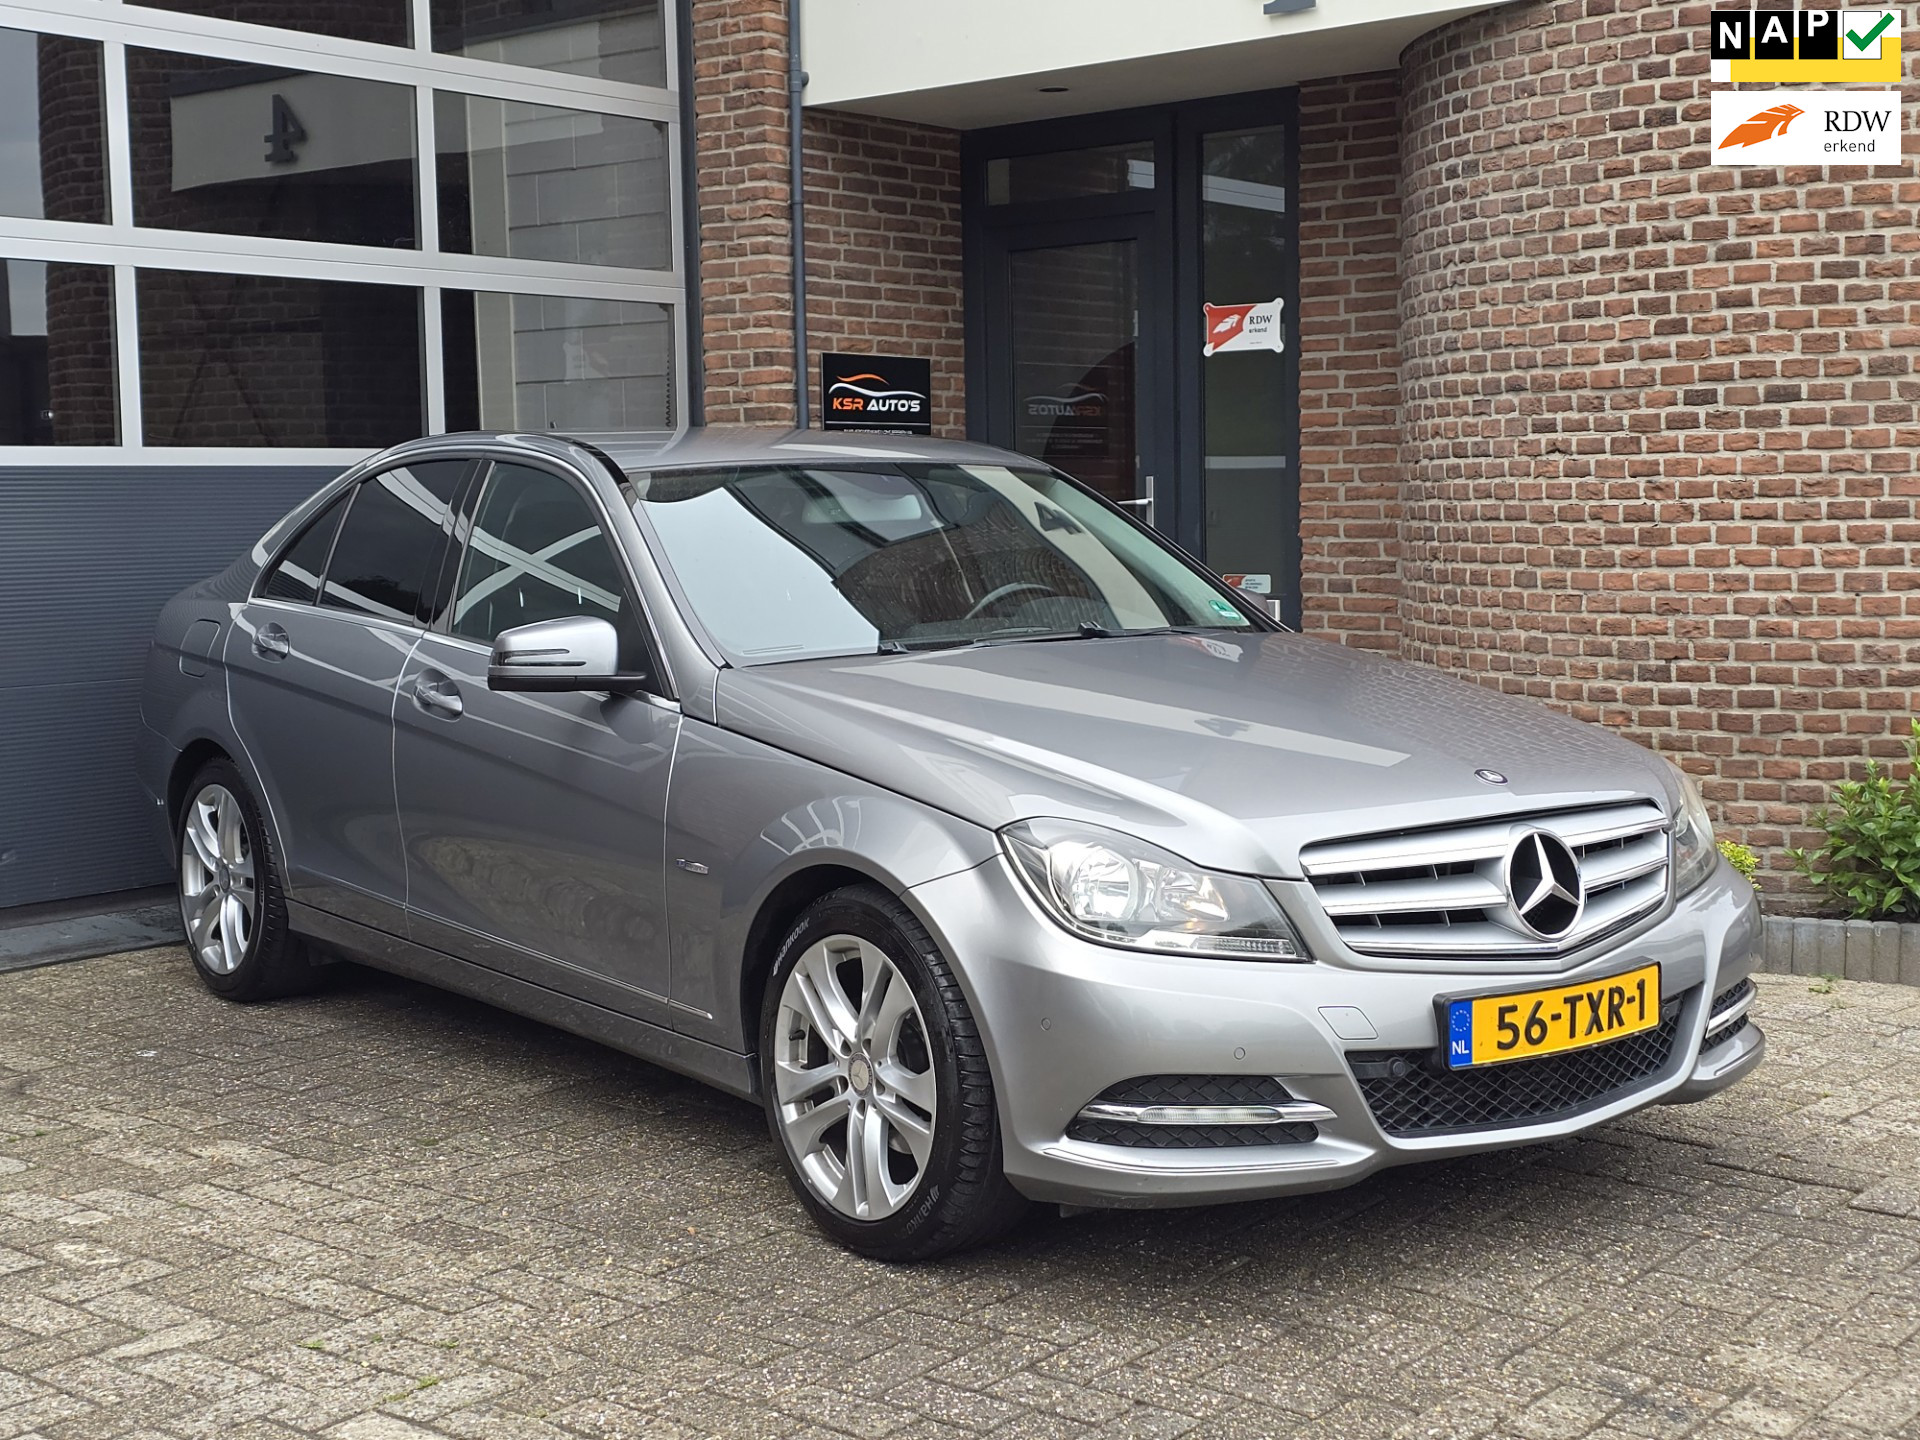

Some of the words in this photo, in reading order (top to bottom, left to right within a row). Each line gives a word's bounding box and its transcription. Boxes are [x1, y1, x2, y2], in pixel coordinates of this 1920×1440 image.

[1249, 314, 1273, 325] RDW
[832, 397, 864, 411] KSR
[867, 398, 921, 412] AUTO'S
[1496, 978, 1646, 1051] 56-TXR-1
[1452, 1041, 1470, 1055] NL
